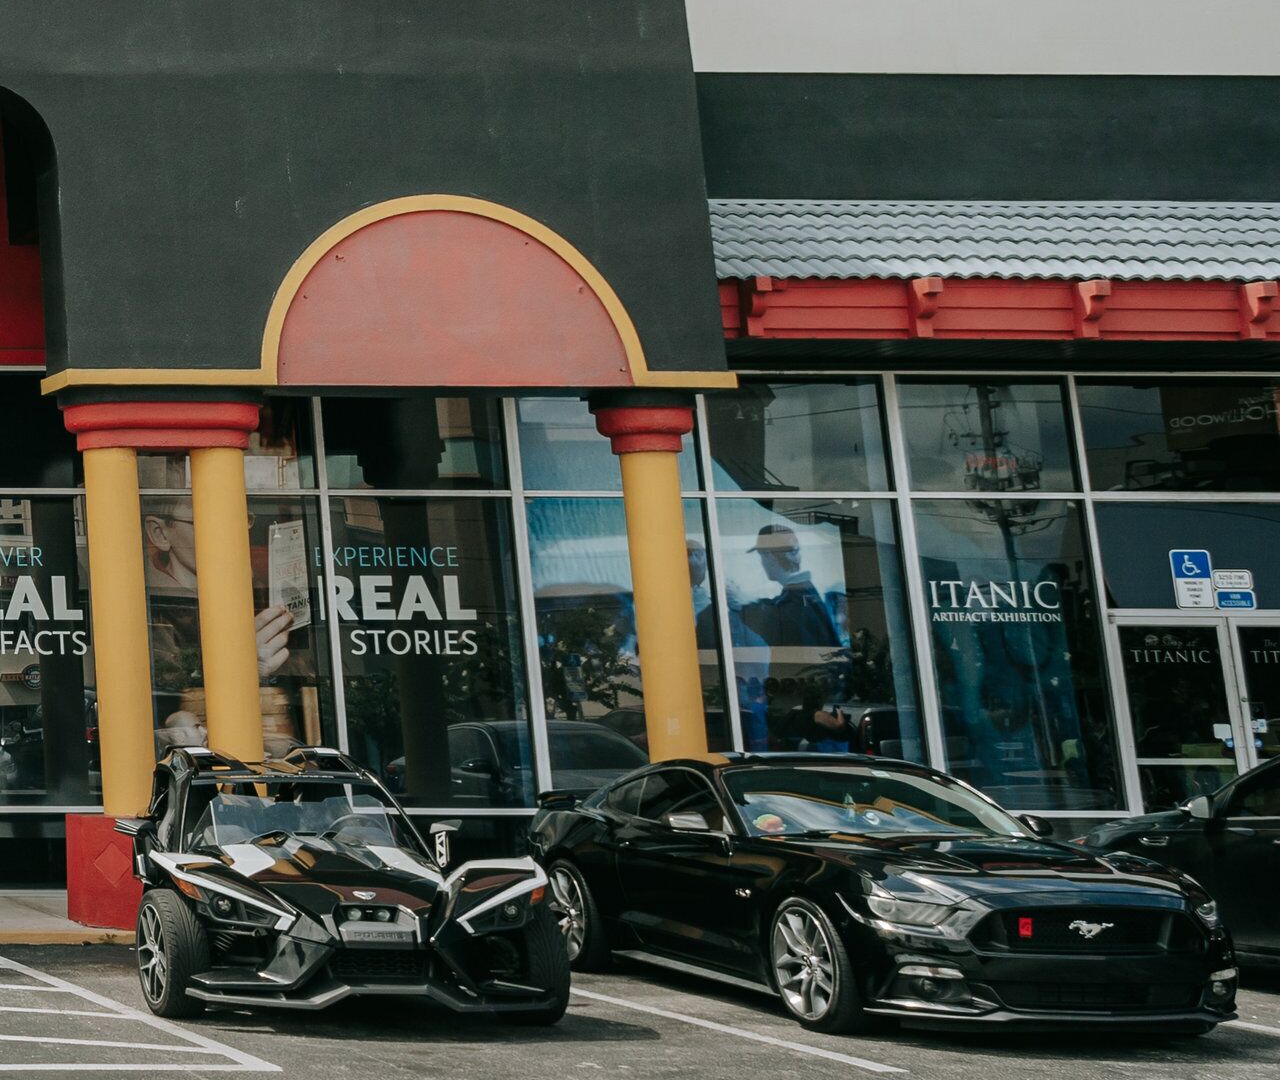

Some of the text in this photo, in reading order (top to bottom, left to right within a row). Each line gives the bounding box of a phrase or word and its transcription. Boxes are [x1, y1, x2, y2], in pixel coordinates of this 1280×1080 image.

[314, 546, 460, 567] EXPERIENCE
[317, 575, 477, 620] REAL
[928, 580, 1060, 609] ITANIC
[932, 612, 1062, 622] ARTIFACT EXHIBITION
[350, 629, 478, 656] STORIES
[1130, 650, 1212, 663] TITANIC
